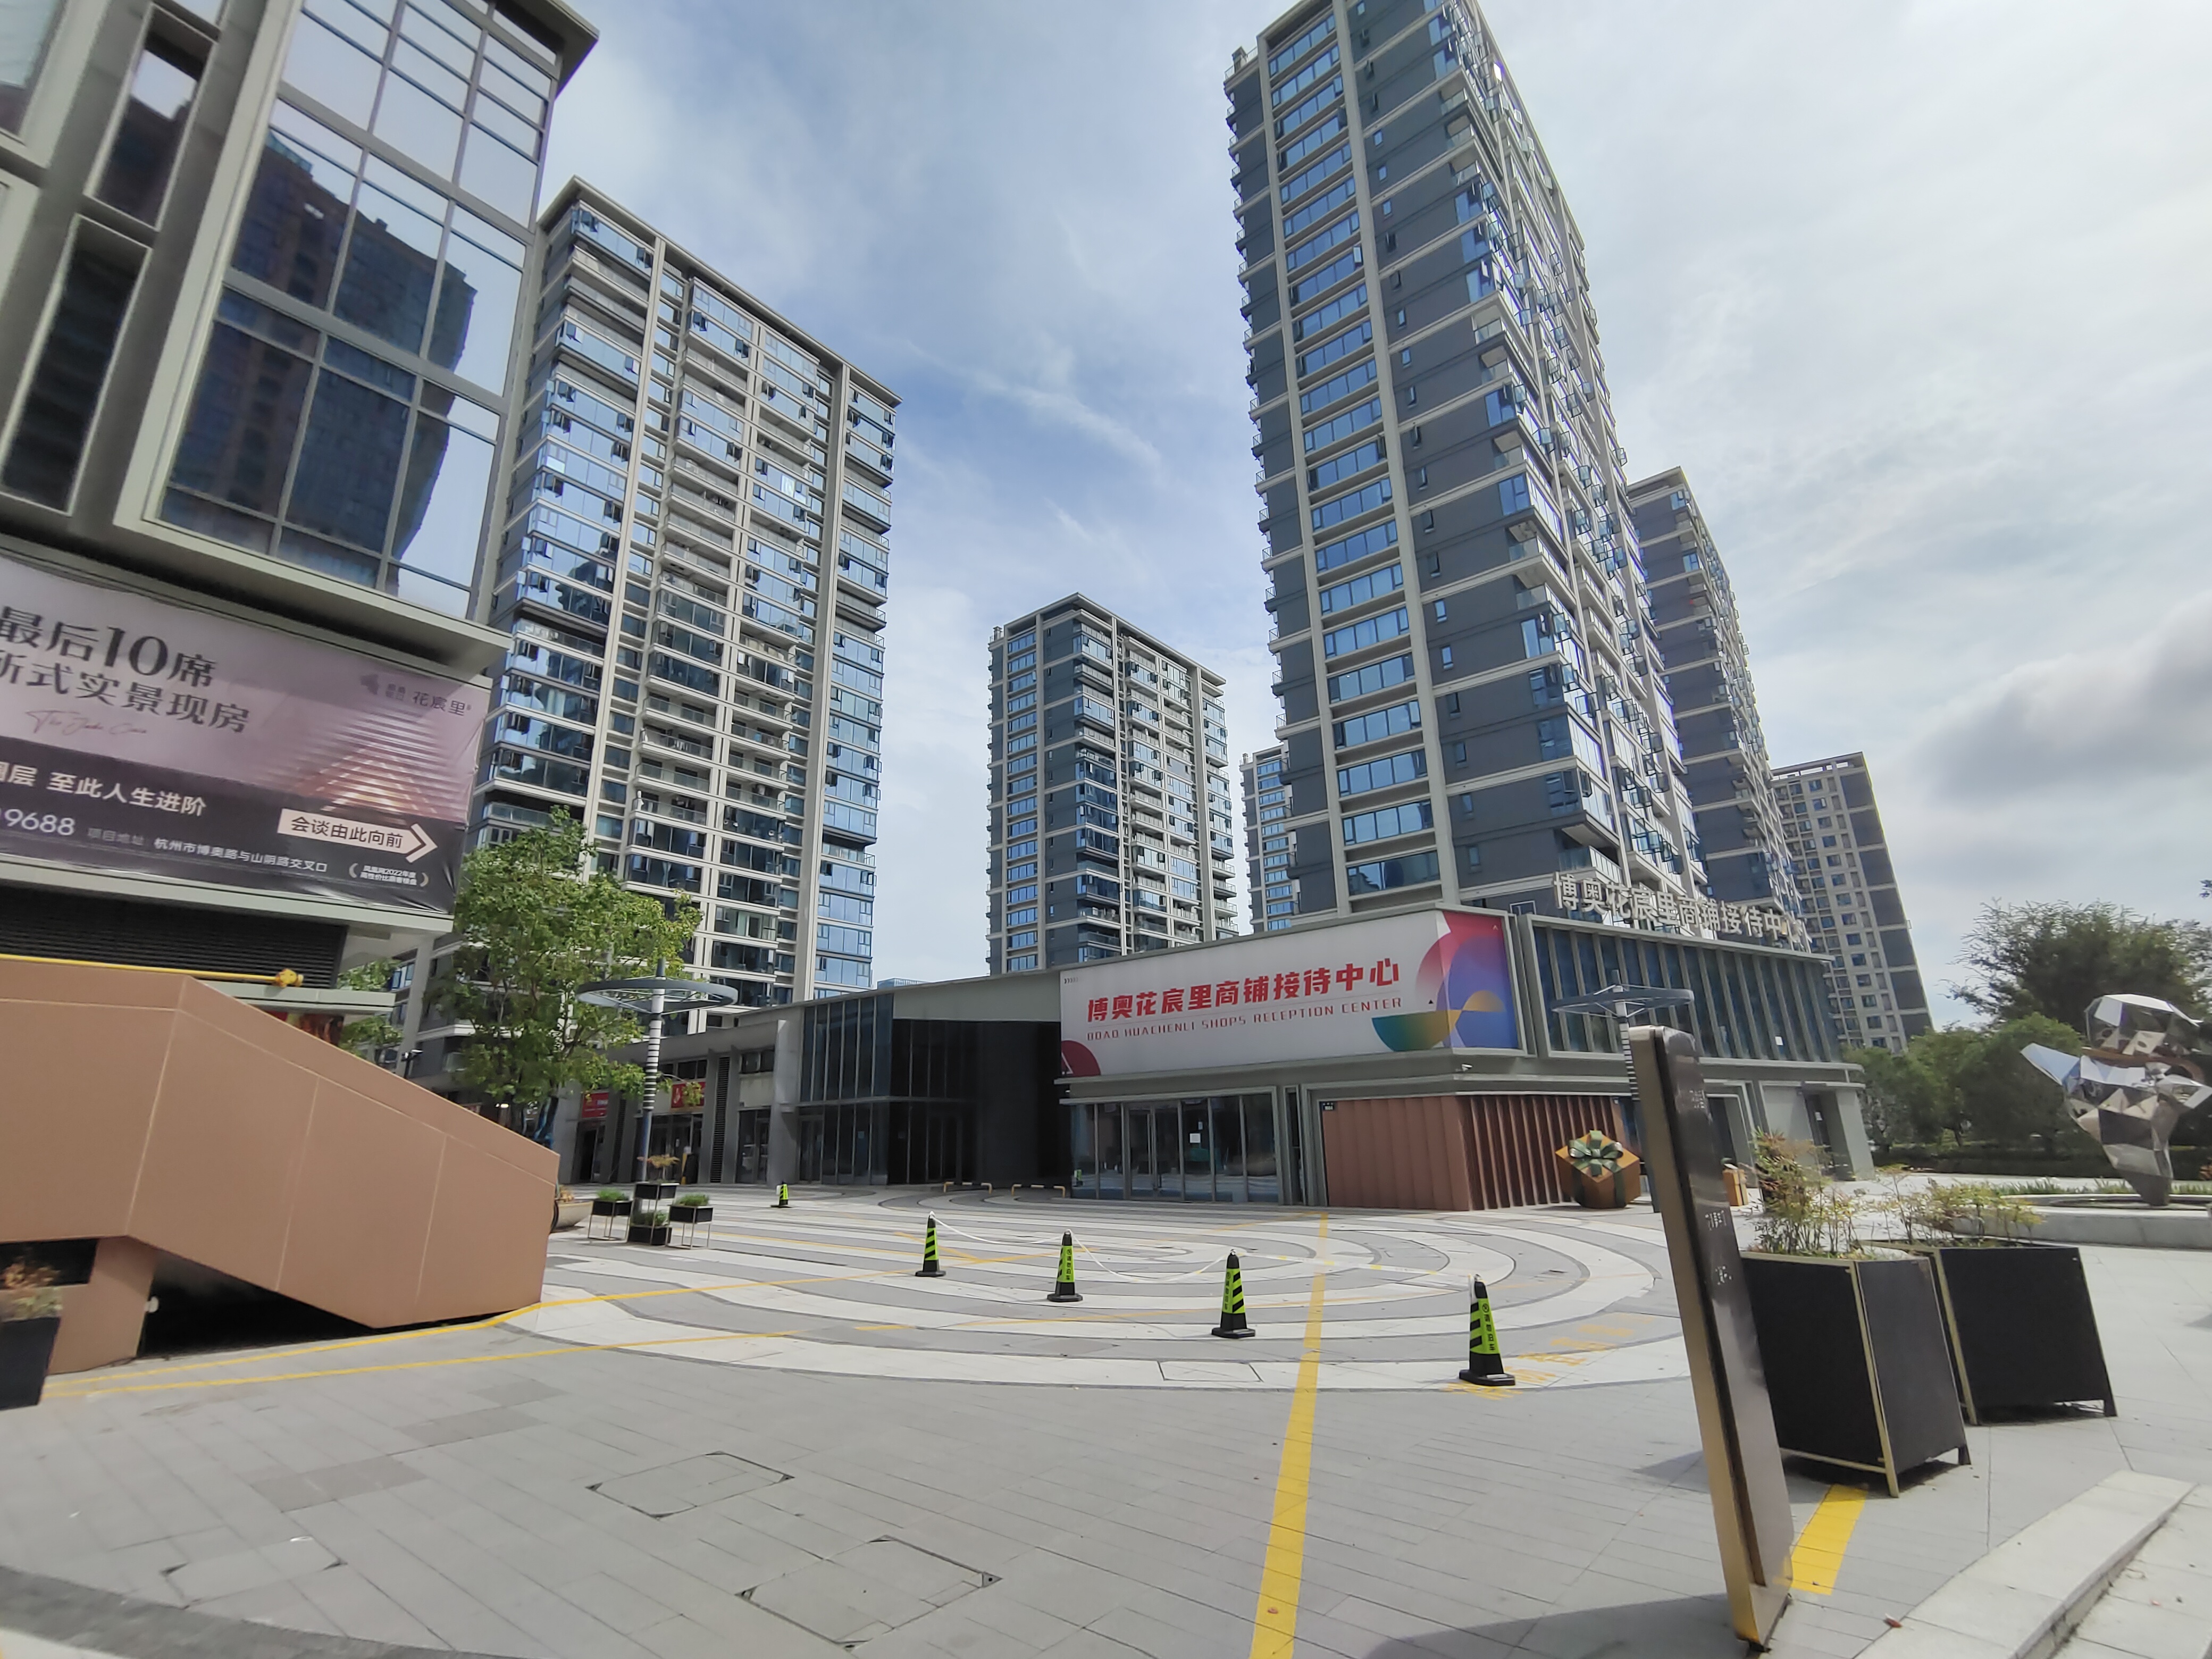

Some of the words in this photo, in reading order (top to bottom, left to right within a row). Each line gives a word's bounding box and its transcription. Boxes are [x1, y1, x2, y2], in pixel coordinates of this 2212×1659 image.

[0, 605, 217, 688] 最后10席
[46, 771, 207, 817] 至此人生进阶
[0, 808, 76, 836] 9688
[291, 816, 404, 849] 会谈由此向前
[1087, 957, 1400, 1023] 博奥花宸里商铺接待中心
[1124, 1021, 1195, 1037] HUACHENLI
[1201, 1015, 1246, 1029] SHOPS
[1253, 1005, 1334, 1024] RECEPTION
[1341, 997, 1402, 1013] CENTER
